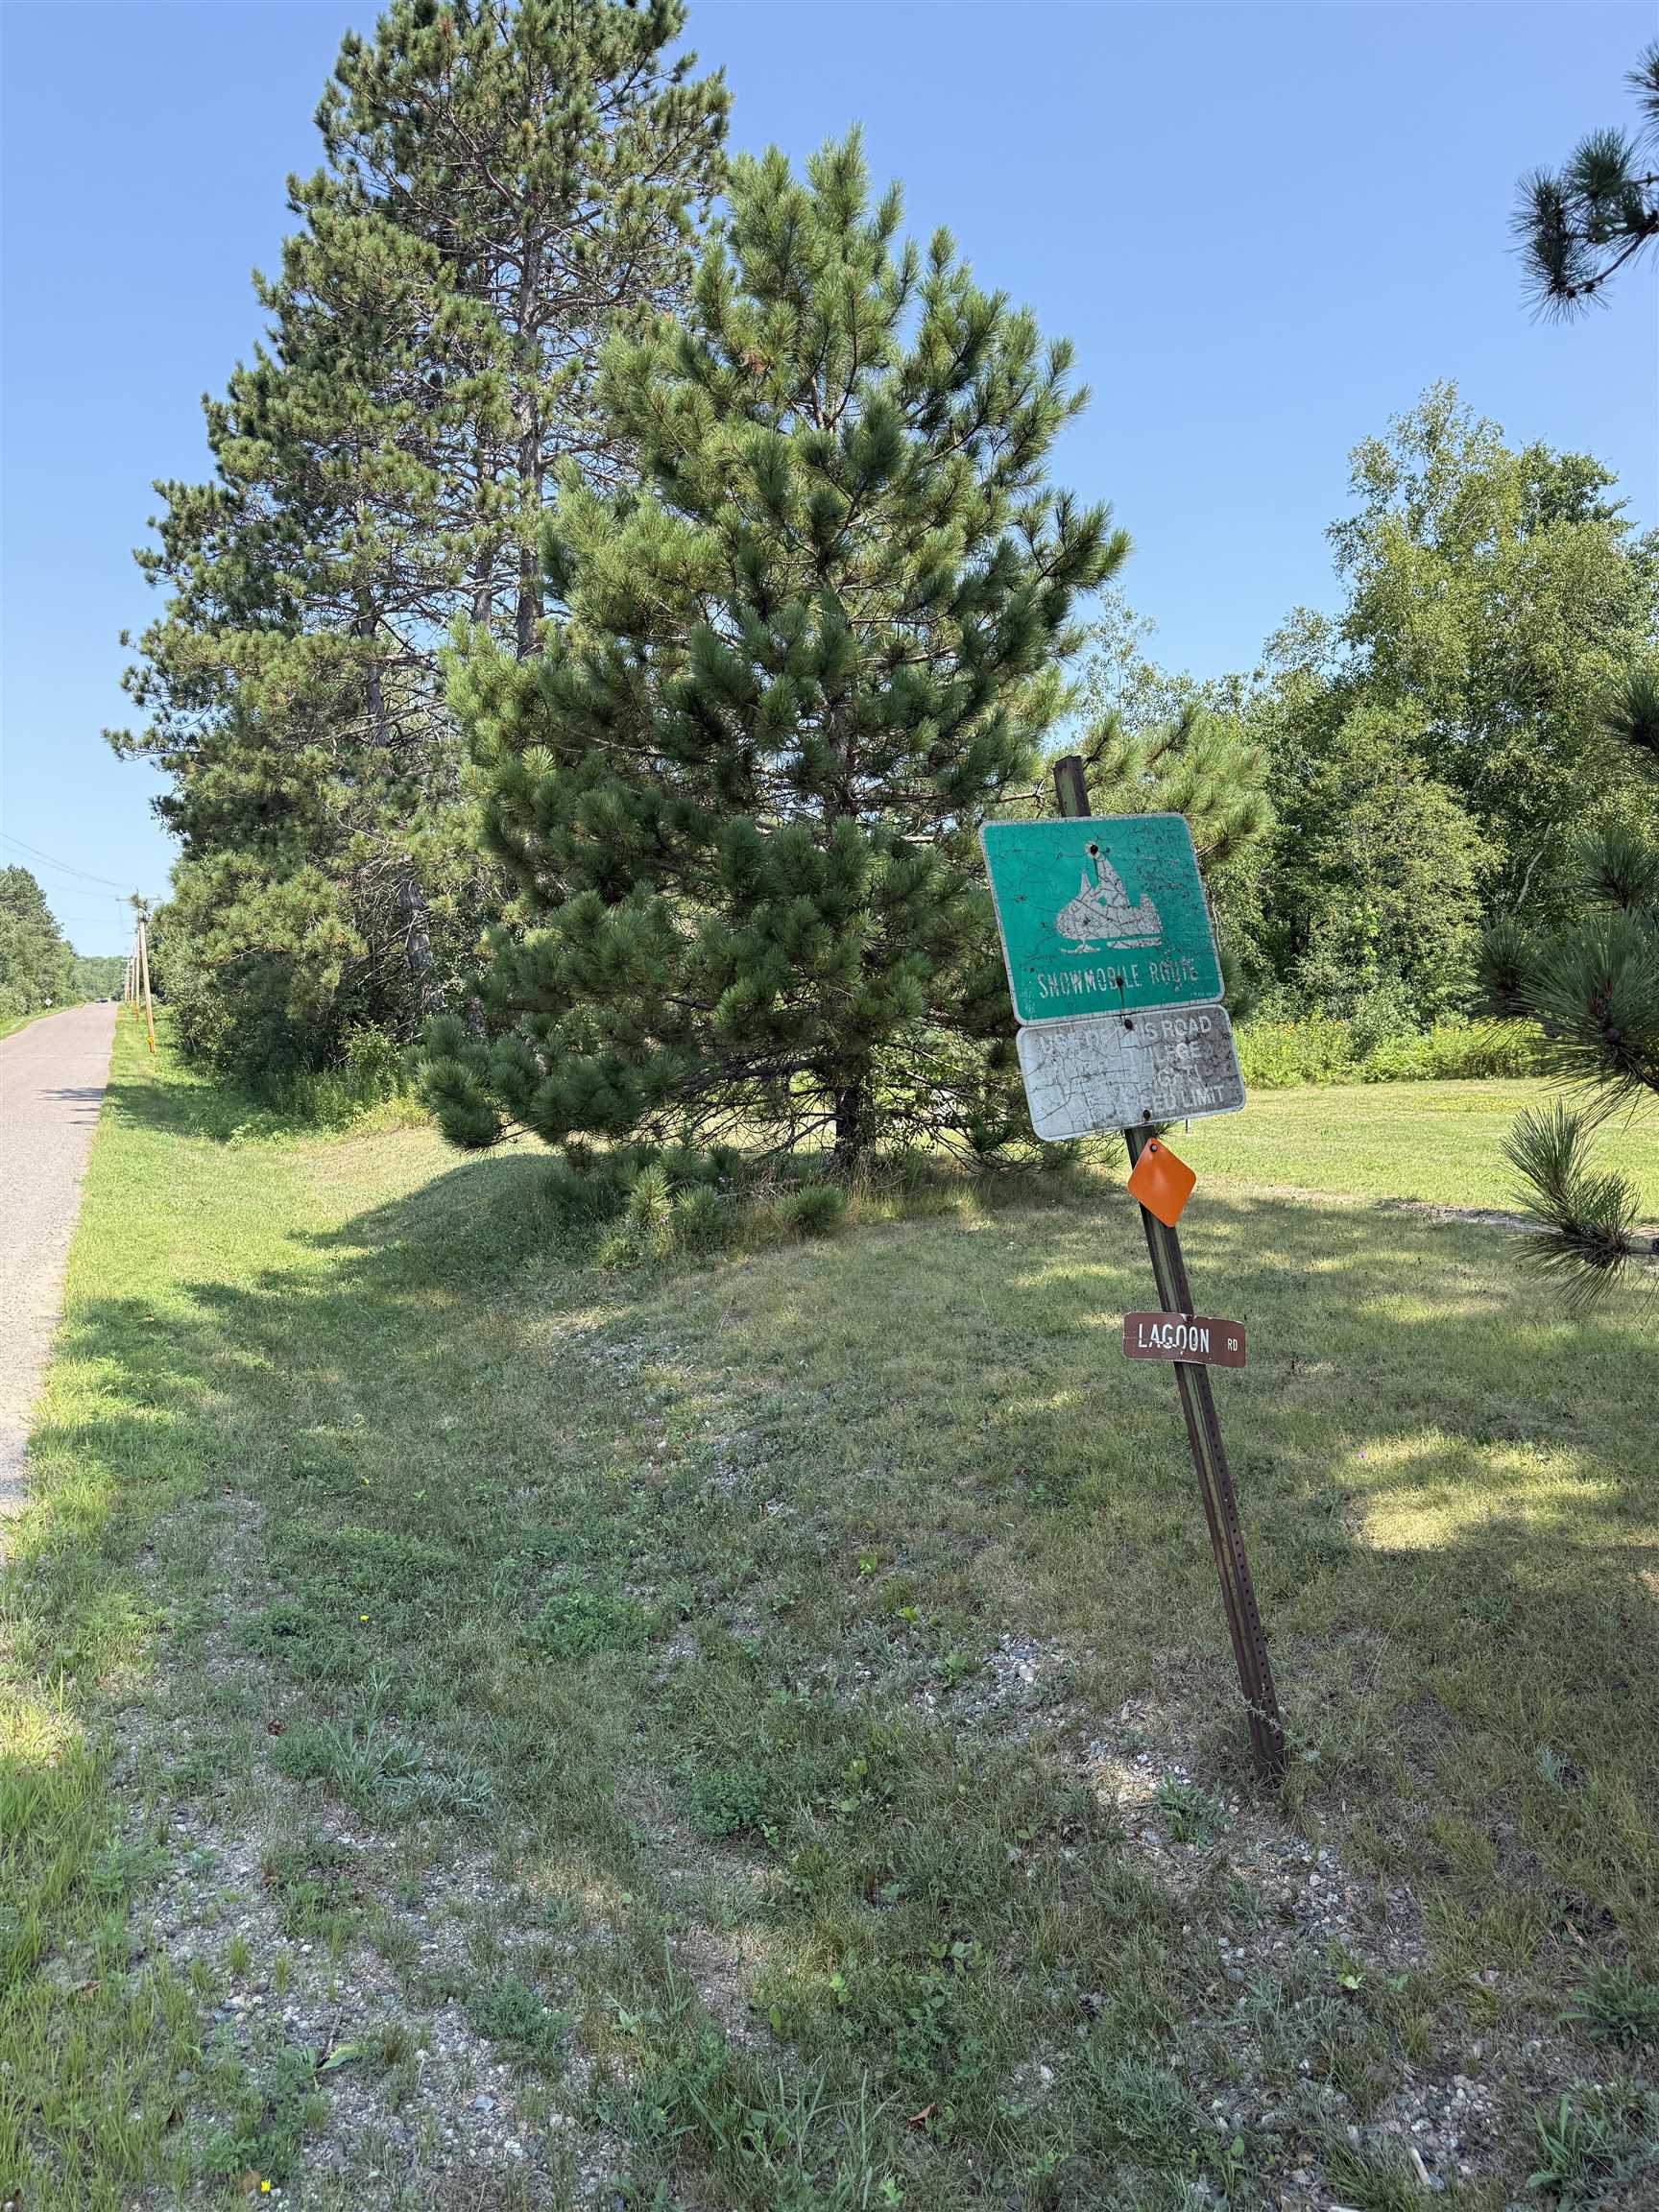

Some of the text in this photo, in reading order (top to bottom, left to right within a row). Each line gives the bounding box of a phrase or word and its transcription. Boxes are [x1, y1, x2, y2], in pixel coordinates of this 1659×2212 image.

[1037, 959, 1199, 998] SNOWMOBILE ROUTE
[1161, 1014, 1213, 1040] ROAD
[1180, 1084, 1225, 1110] LIMIT
[1138, 1323, 1238, 1354] LAGOON RD
